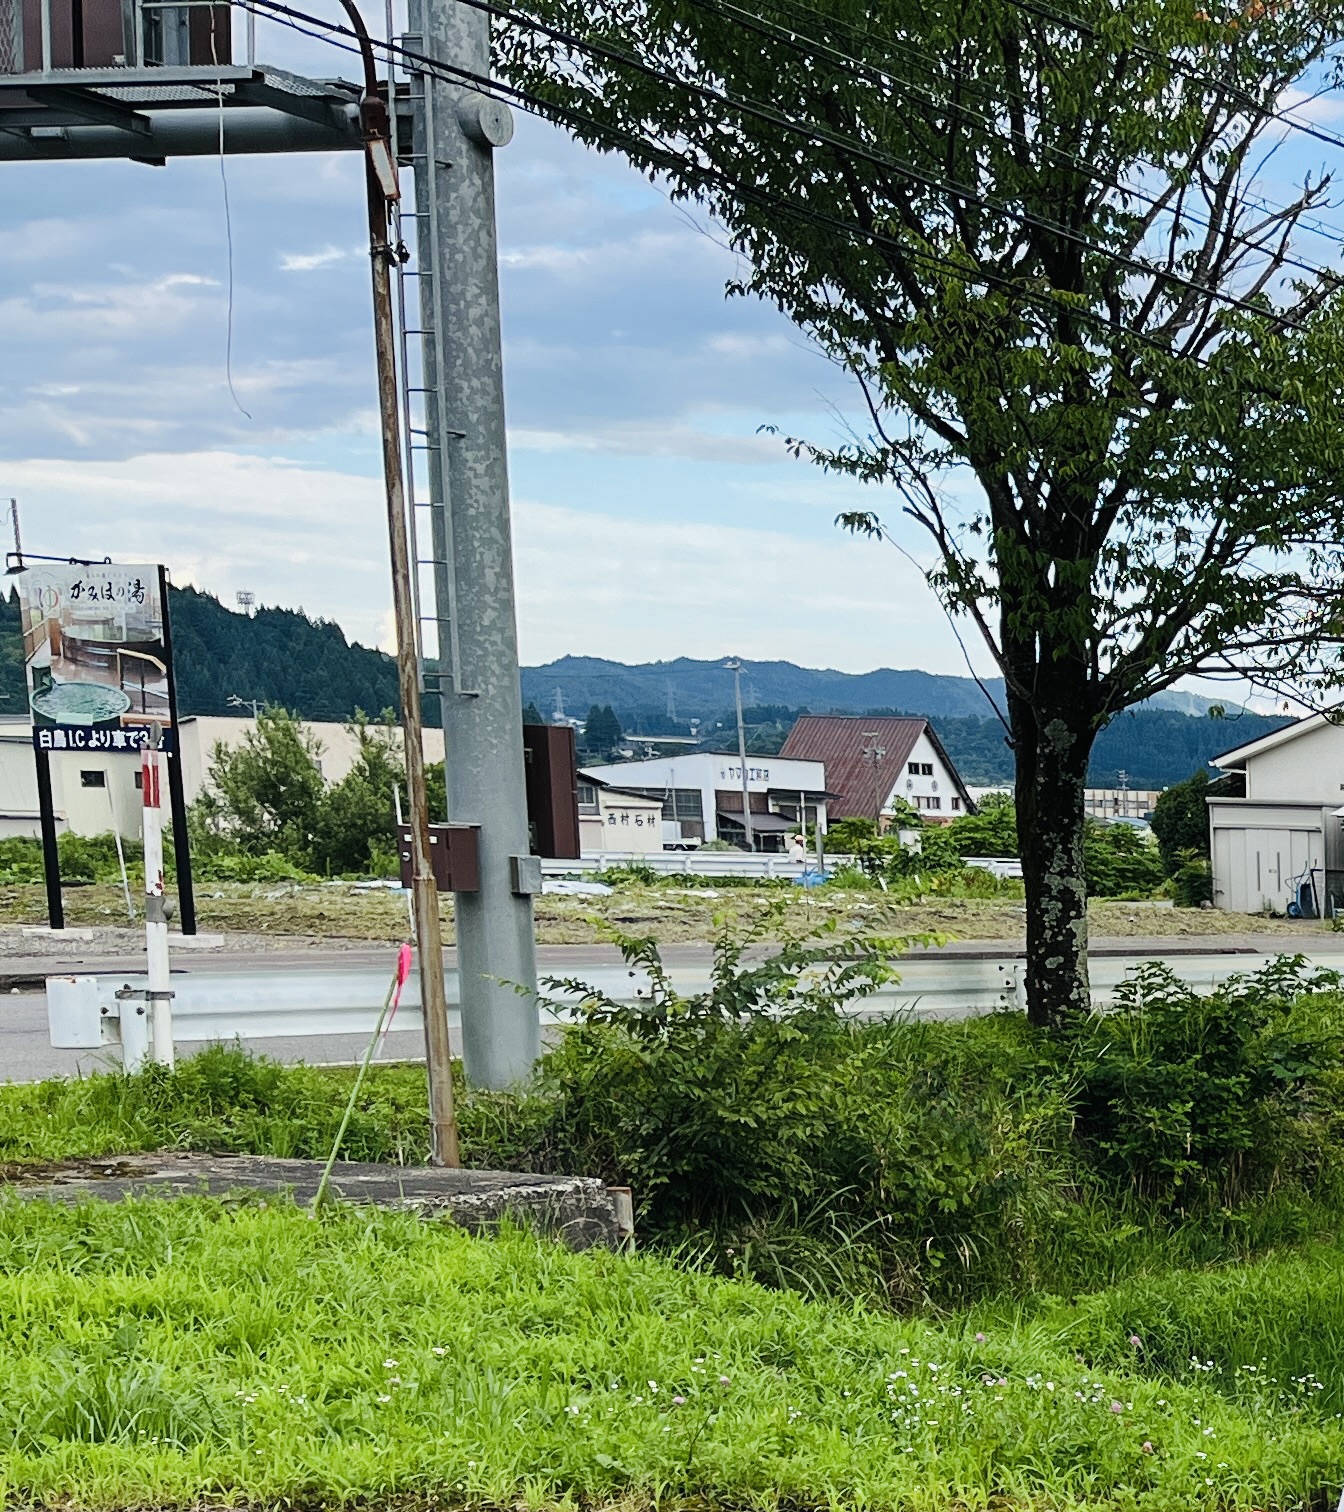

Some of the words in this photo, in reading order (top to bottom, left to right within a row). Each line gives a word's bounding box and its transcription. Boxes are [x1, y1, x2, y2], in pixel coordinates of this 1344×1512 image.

[38, 728, 166, 750] 白鳥I.Cより車で3
[607, 811, 656, 828] 西村石材
